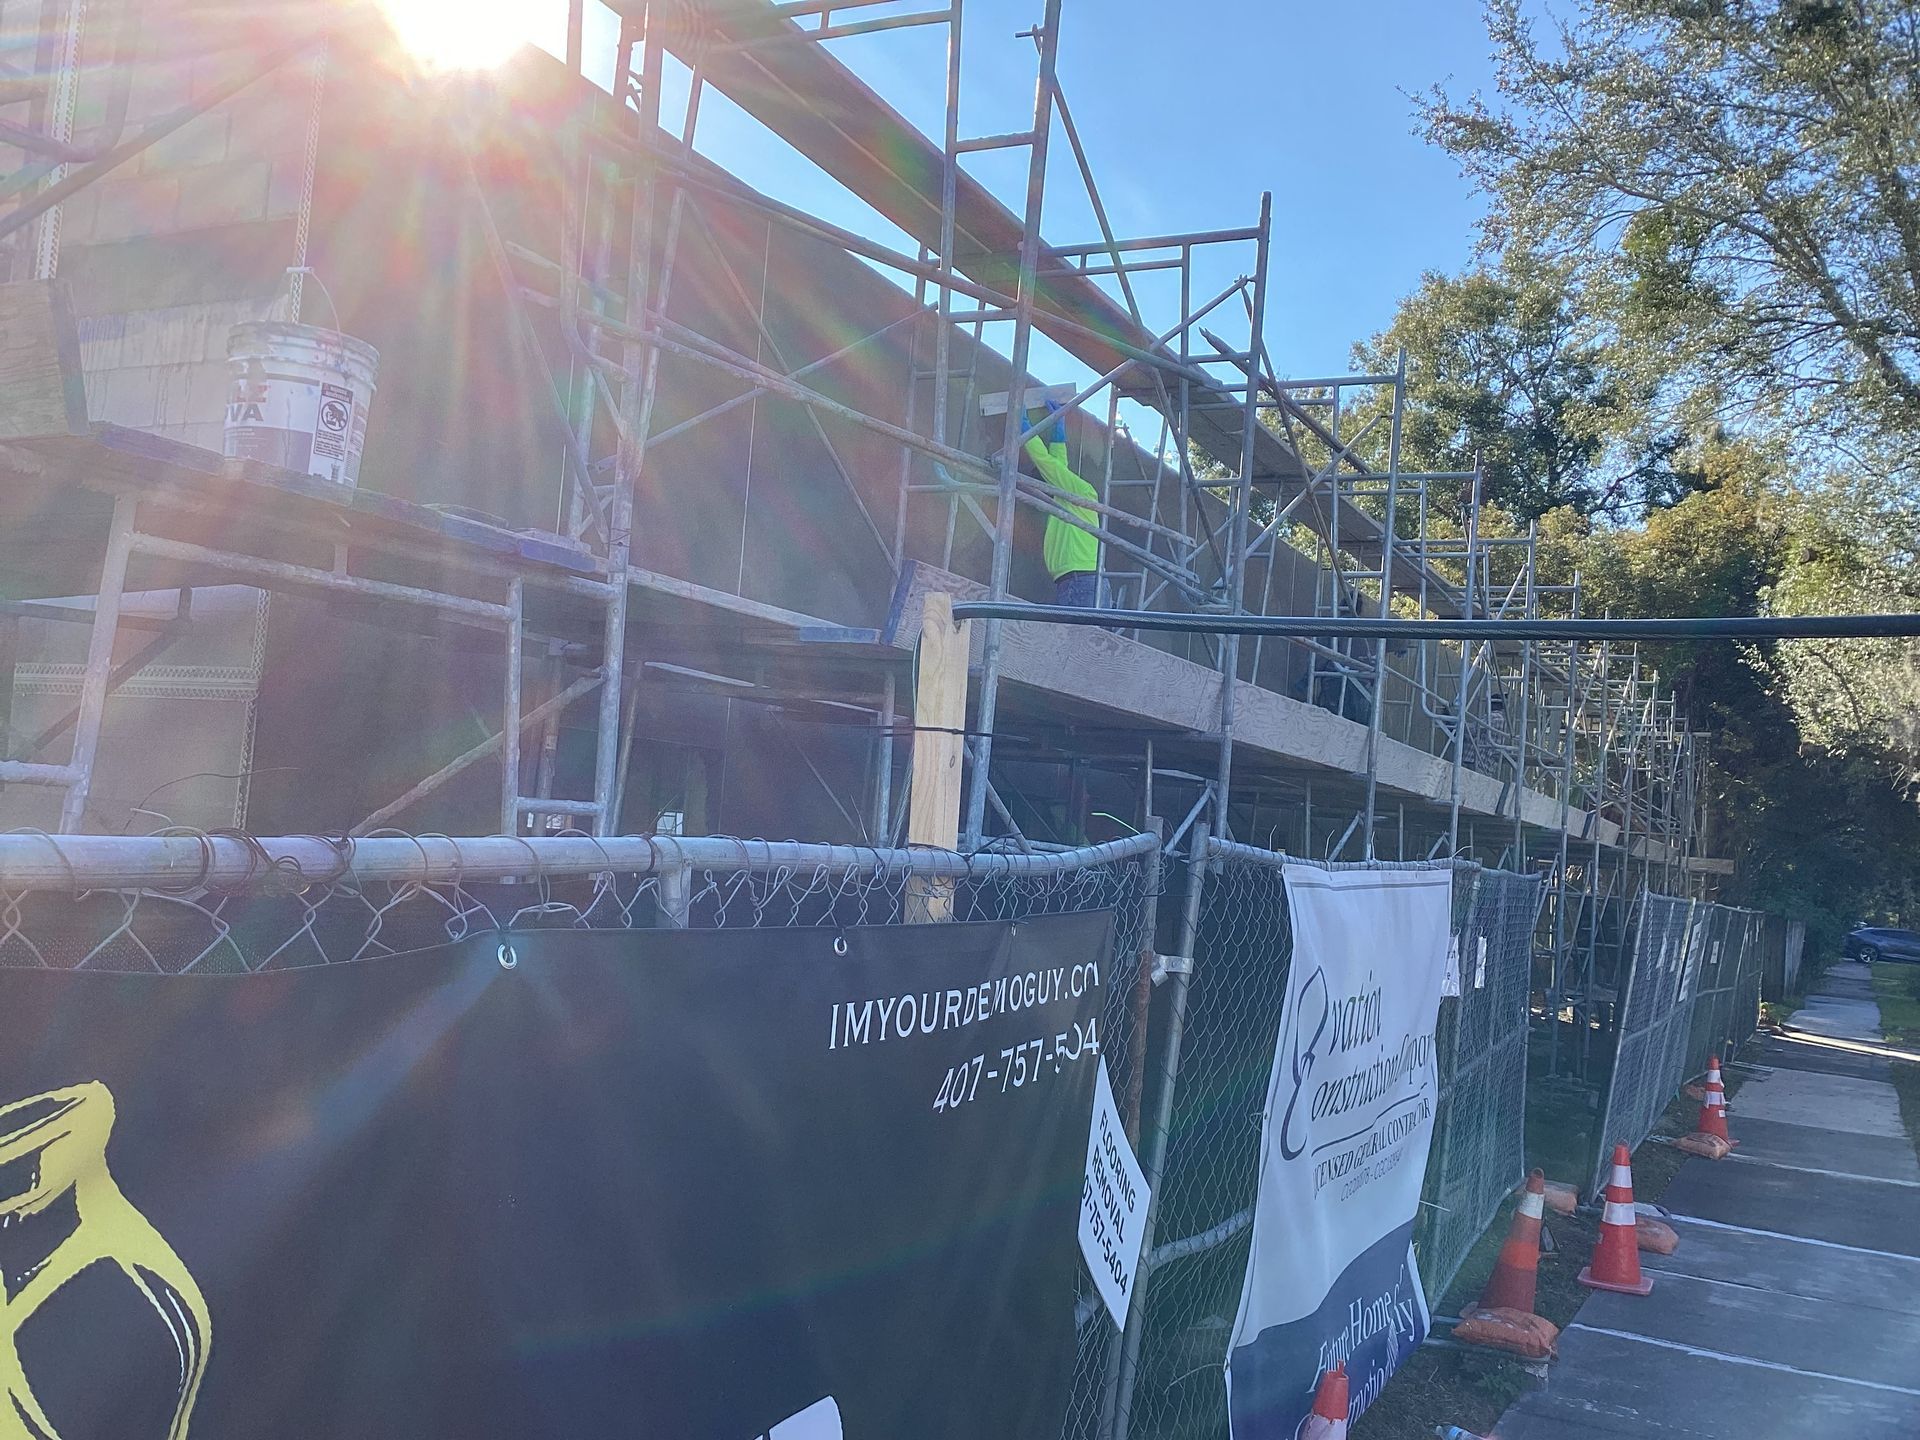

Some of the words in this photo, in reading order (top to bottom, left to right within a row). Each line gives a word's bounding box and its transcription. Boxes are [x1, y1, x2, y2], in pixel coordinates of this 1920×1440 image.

[1091, 1143, 1125, 1245] REMOVAL
[1100, 1108, 1136, 1214] FLOORING
[1349, 1297, 1392, 1351] Home
